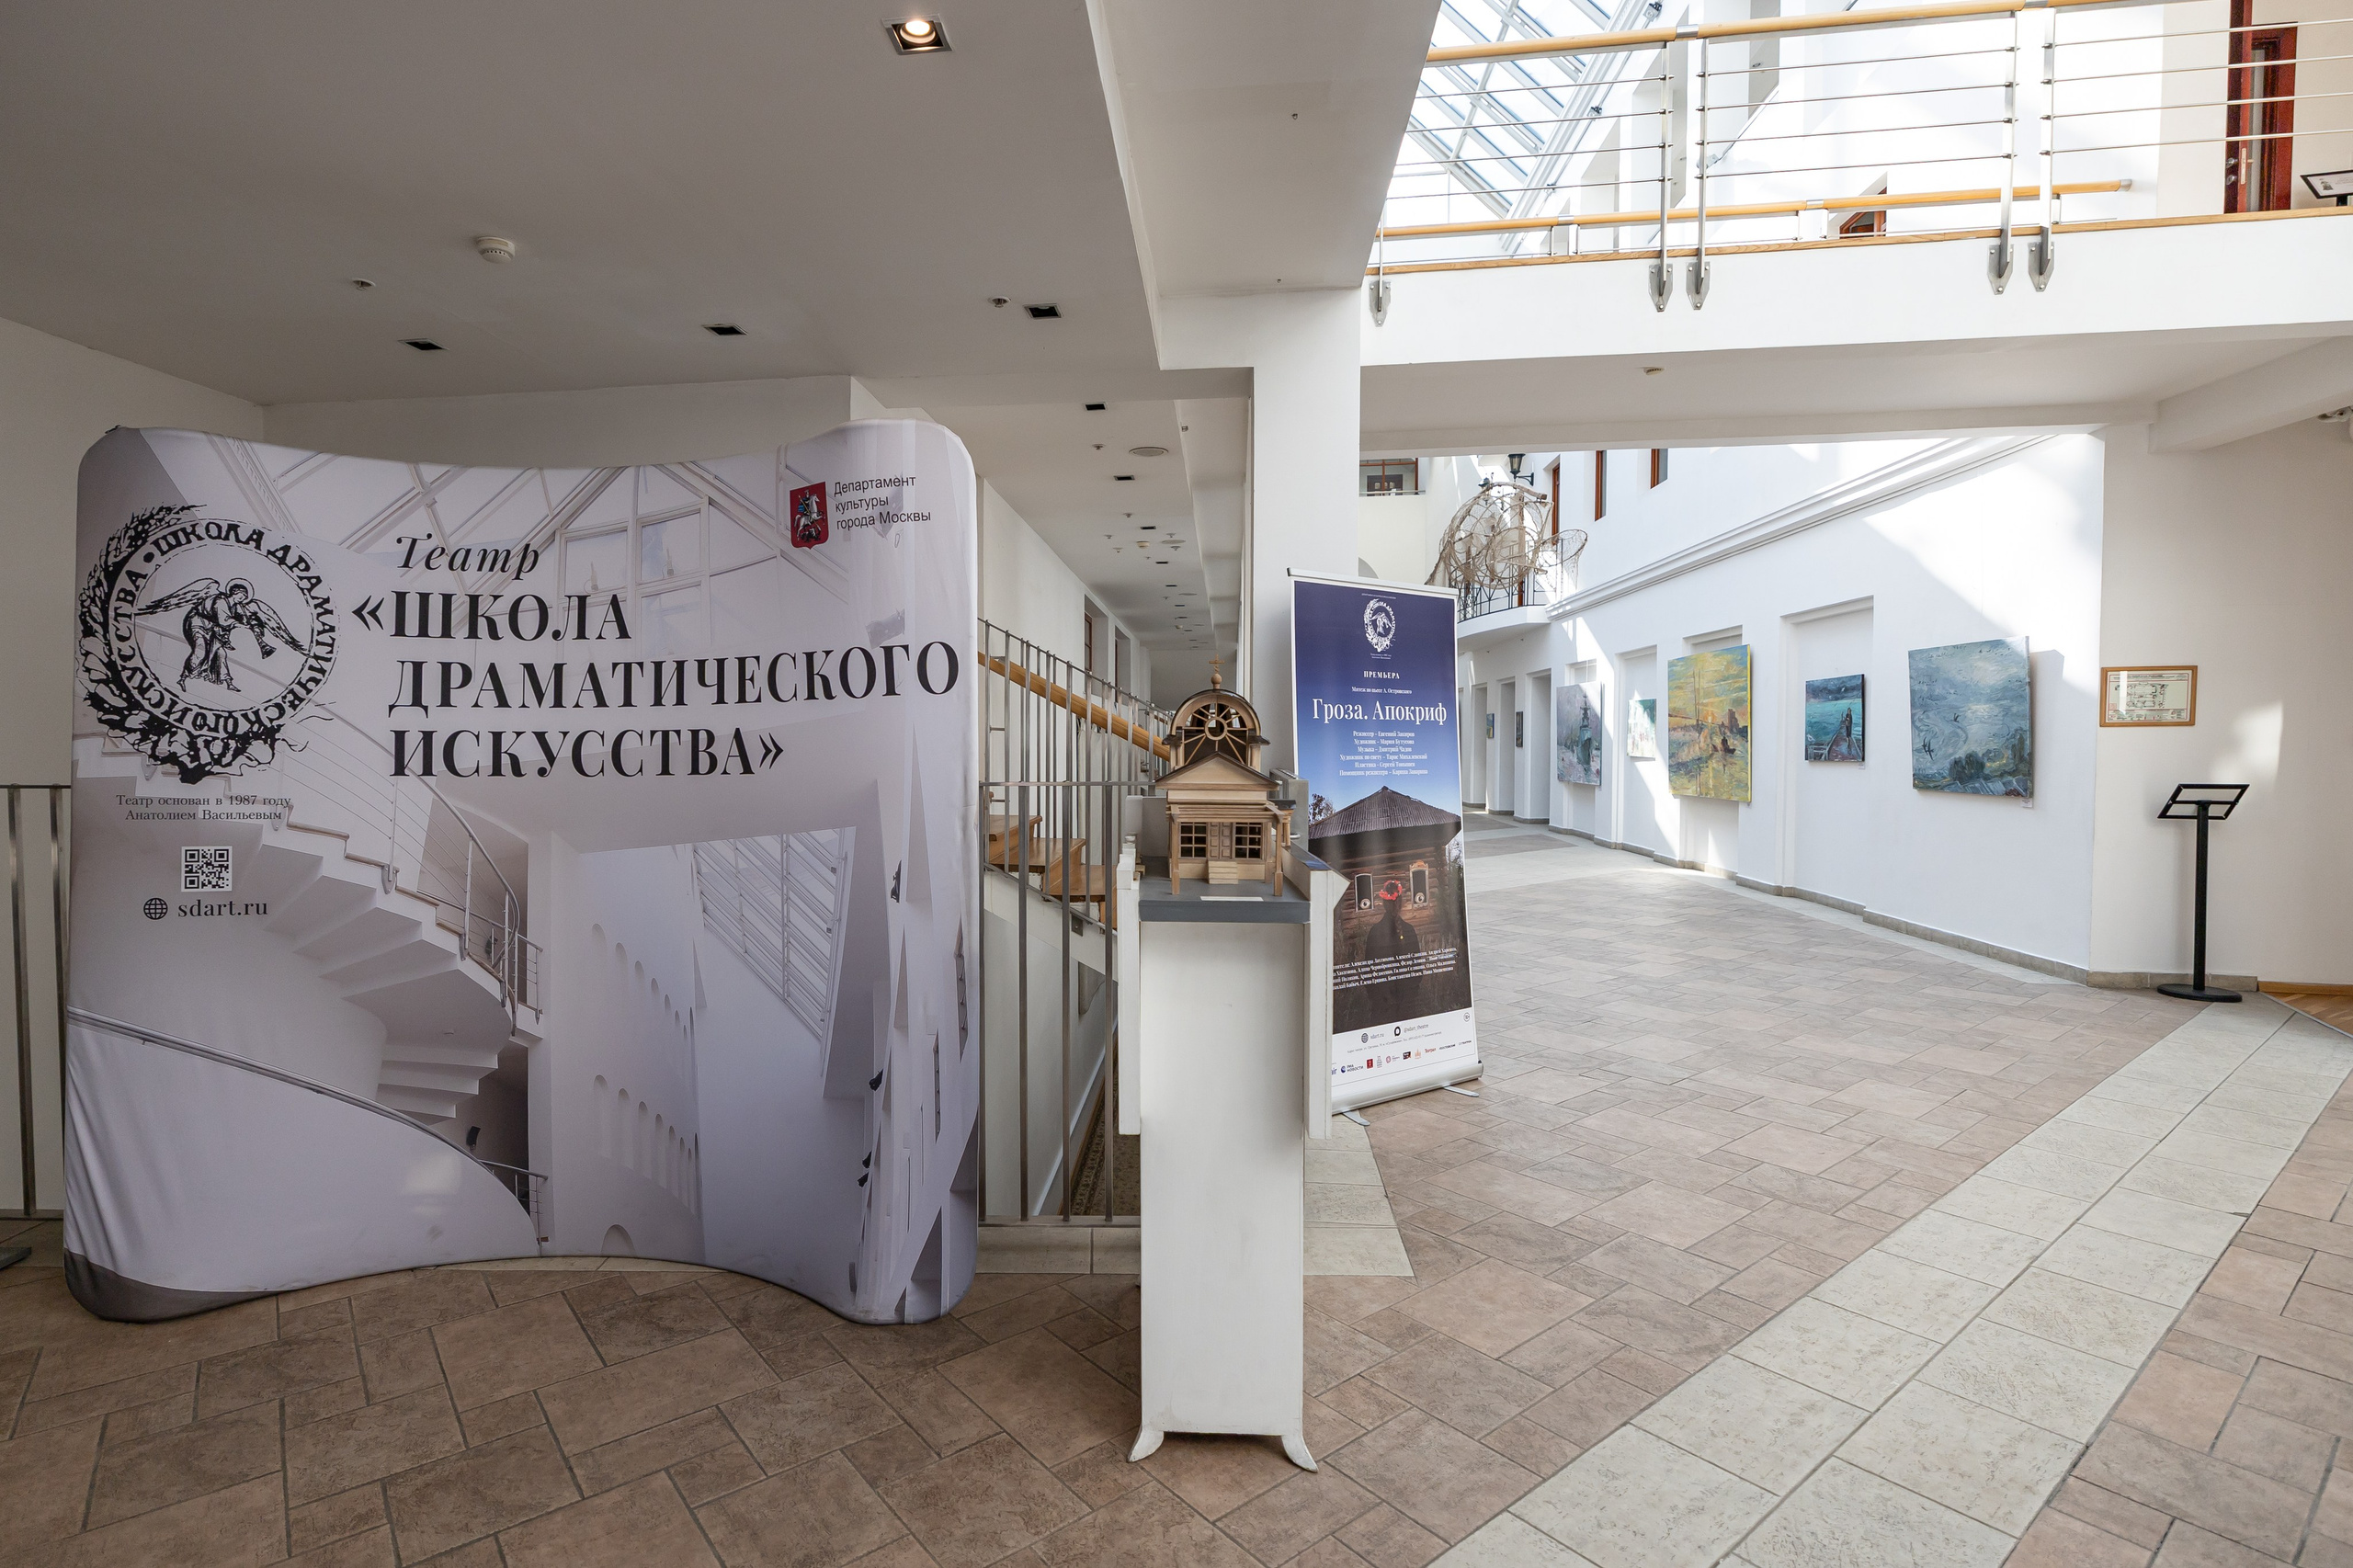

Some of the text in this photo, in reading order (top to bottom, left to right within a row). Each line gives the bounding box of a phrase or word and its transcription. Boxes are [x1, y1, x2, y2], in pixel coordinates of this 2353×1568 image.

[834, 476, 916, 498] Департамент
[835, 496, 890, 516] культуры
[836, 511, 931, 531] города Москвы
[149, 521, 266, 557] ШКОЛА
[396, 533, 540, 581] Театр
[351, 590, 632, 642] «ШКОЛА
[387, 641, 959, 720] ДРАМАТИЧЕСКОГО
[1363, 670, 1400, 679] ПРЕМЬЕРА
[1312, 699, 1447, 725] Гроза. Апокриф
[389, 727, 784, 778] ИСКУССТВА»
[116, 794, 290, 812] Театр основан в 1987 году
[125, 809, 281, 821] Анатолием Васильевым
[177, 898, 268, 918] sdart.ru
